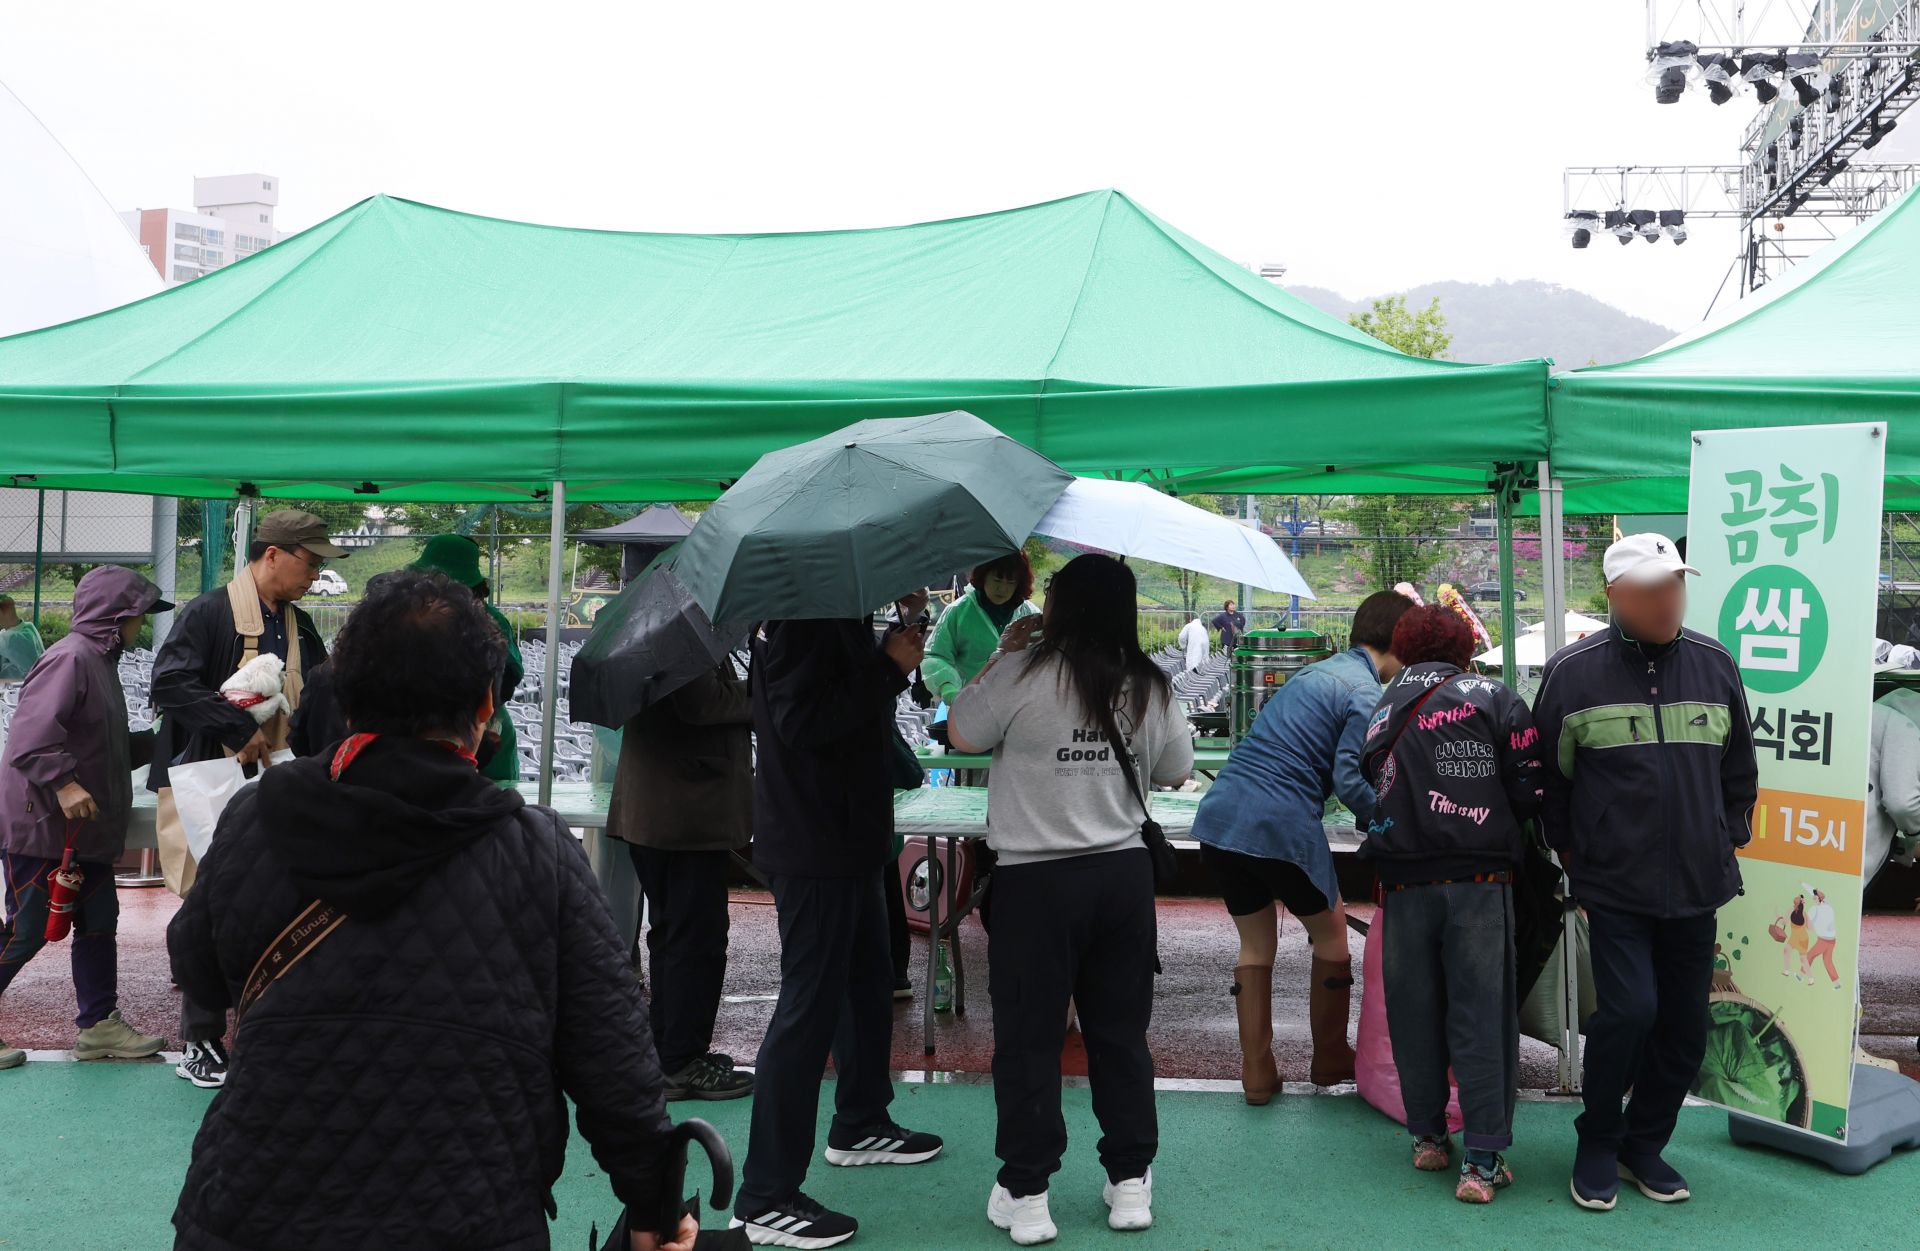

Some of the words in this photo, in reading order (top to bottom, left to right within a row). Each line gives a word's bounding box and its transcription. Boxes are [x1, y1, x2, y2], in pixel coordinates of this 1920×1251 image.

[1720, 463, 1839, 566] 곰취
[1735, 587, 1811, 673] 쌈
[1056, 747, 1109, 761] Good
[1435, 740, 1494, 760] LUCIFER
[1752, 706, 1833, 766] 식회
[1779, 806, 1846, 852] 15시
